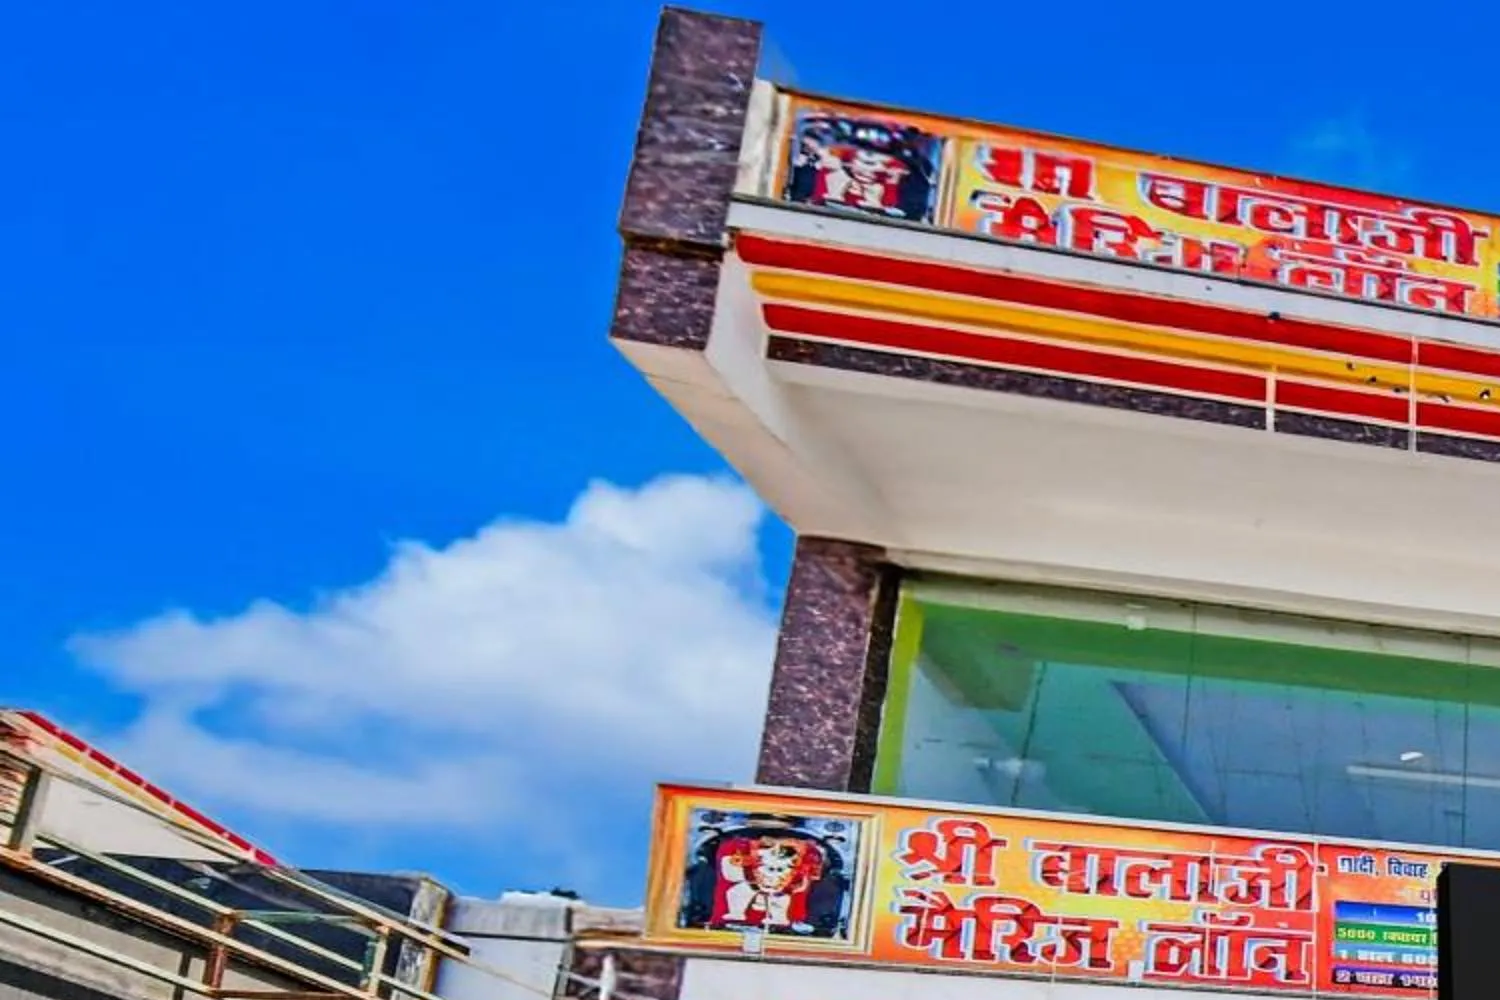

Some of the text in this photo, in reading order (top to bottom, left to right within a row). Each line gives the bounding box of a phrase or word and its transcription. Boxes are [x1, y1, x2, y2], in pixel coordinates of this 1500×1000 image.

[896, 815, 1327, 912] श्री बालाजी
[891, 889, 1315, 984] मैरिज लॉन
